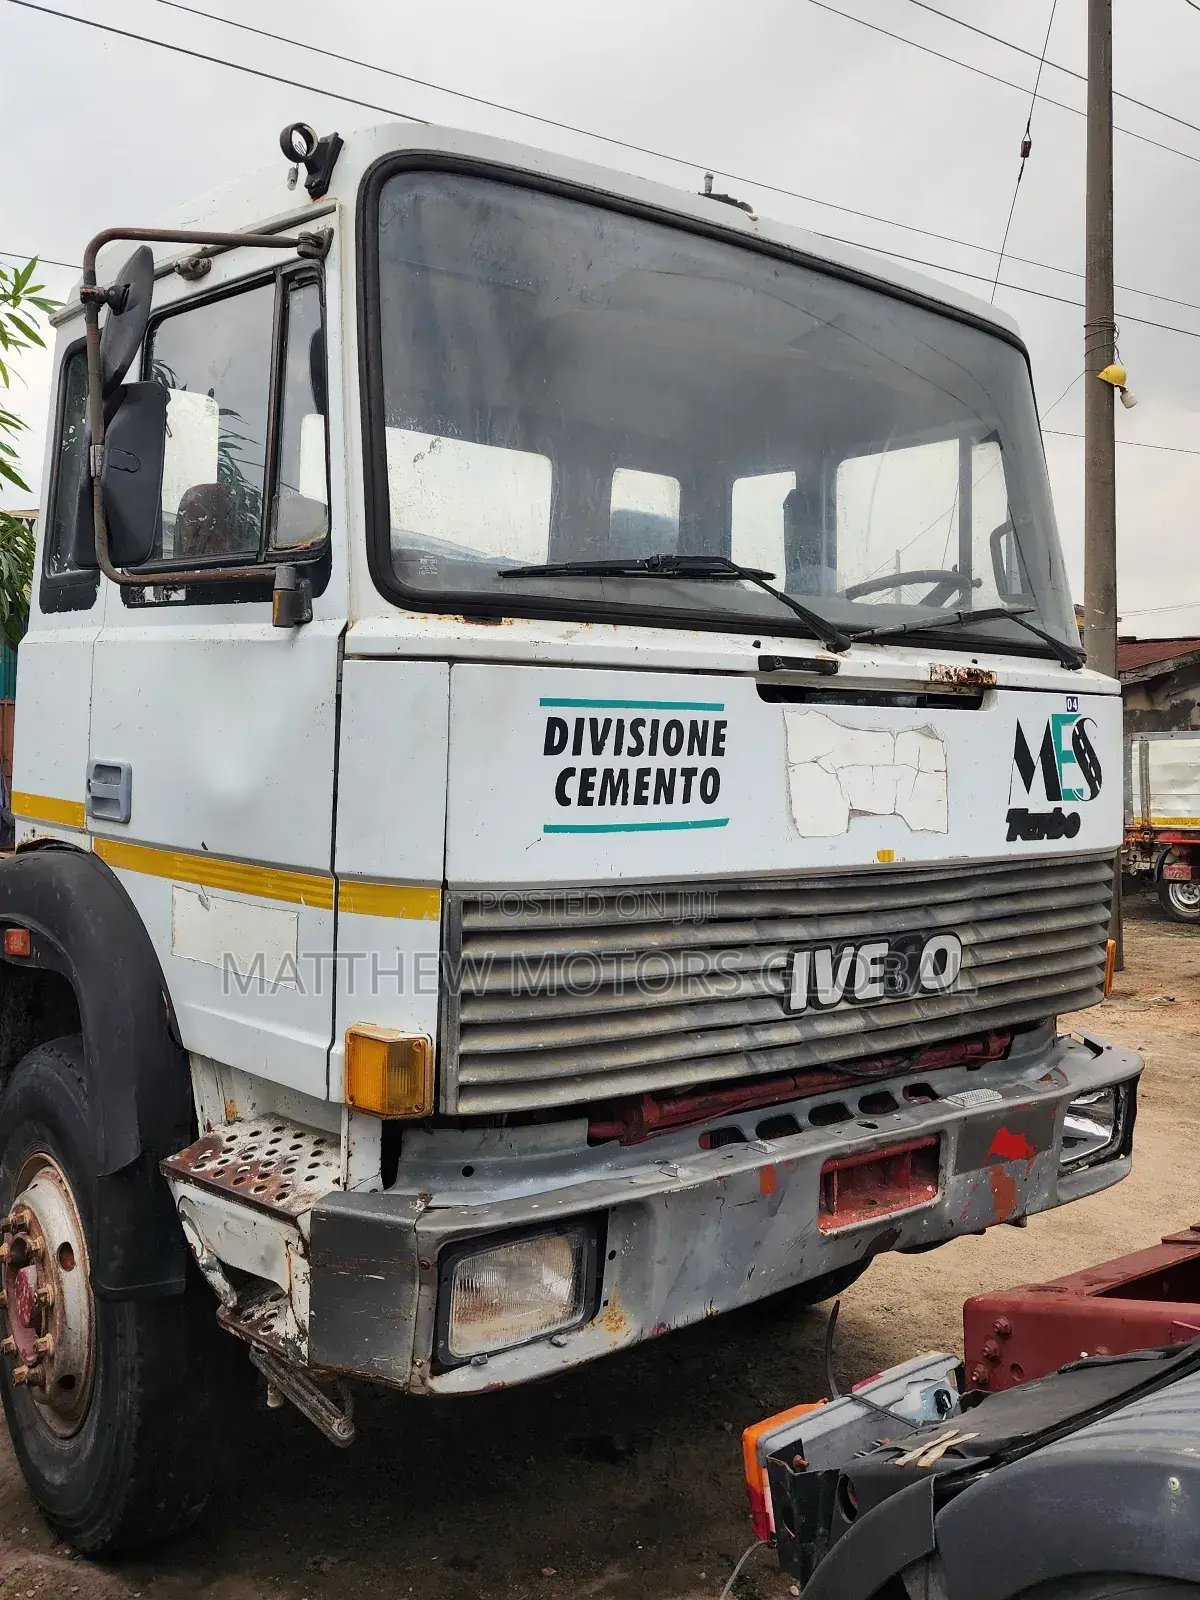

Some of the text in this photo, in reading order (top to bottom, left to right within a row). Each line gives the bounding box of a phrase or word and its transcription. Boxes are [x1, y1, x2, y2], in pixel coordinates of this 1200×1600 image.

[1067, 698, 1078, 711] 04
[543, 716, 728, 757] DIVISIONE
[555, 766, 721, 807] CEMENTO
